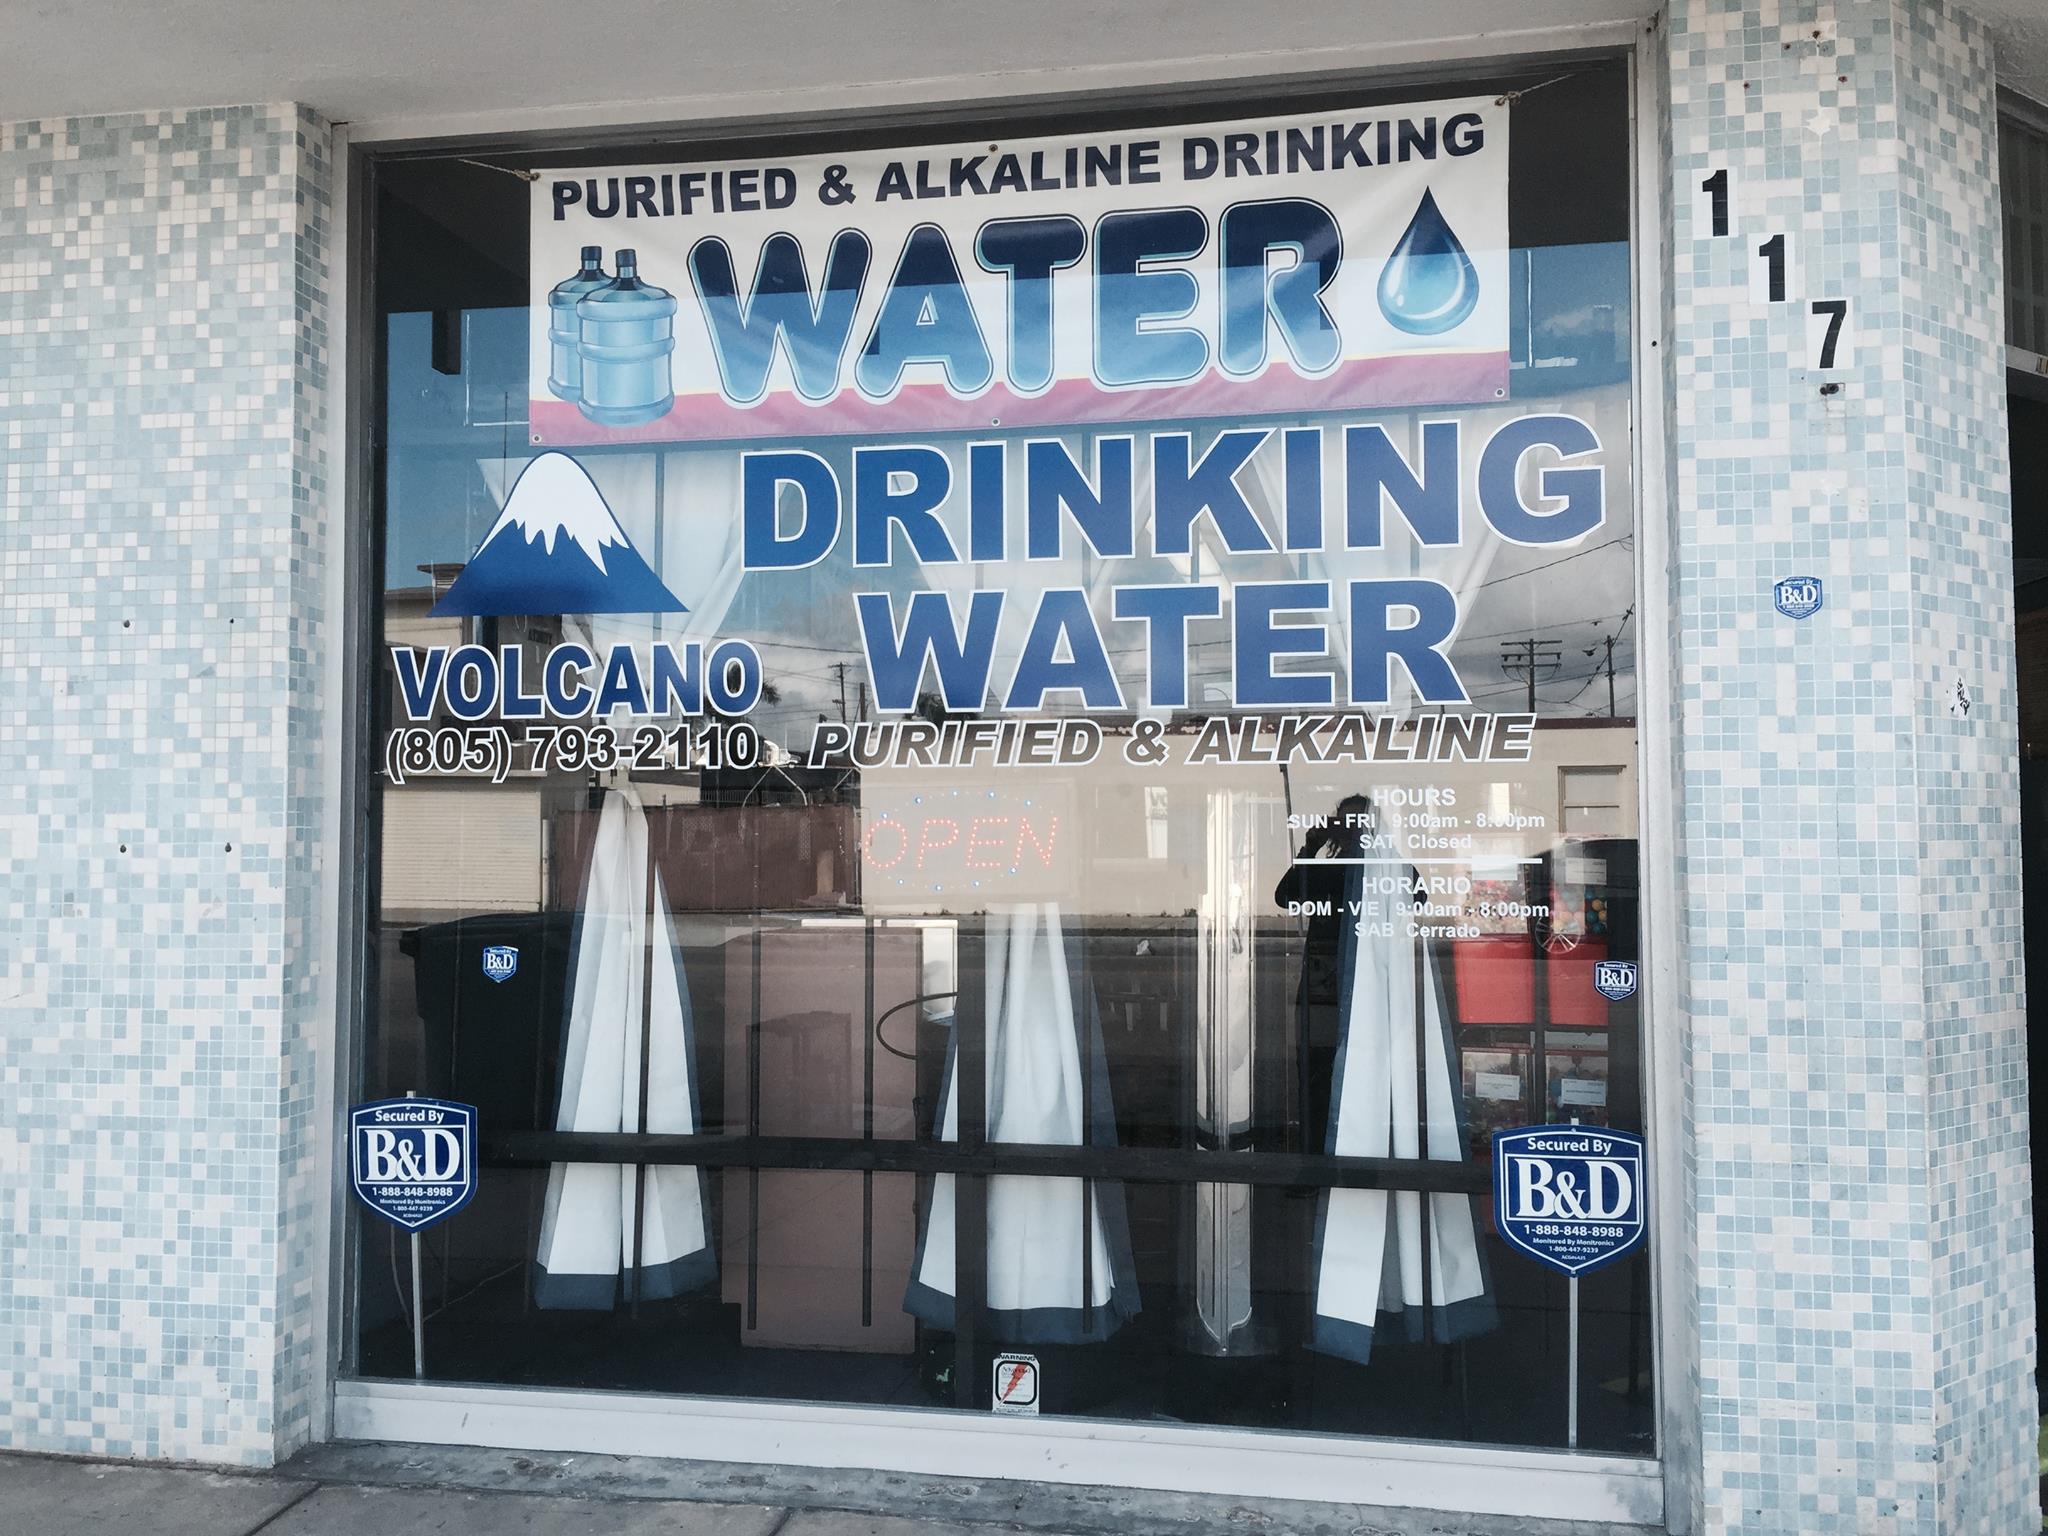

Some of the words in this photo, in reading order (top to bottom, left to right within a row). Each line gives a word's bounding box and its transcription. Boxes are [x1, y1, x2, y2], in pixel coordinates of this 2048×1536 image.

[552, 167, 797, 221] PURIFIED
[818, 165, 857, 205] &
[875, 140, 1161, 202] ALKALINE
[1183, 112, 1485, 181] DRINKING
[1702, 169, 1729, 236] 1
[1759, 234, 1786, 302] 1
[1812, 301, 1847, 369] 7
[686, 196, 1344, 407] WATER
[740, 413, 1606, 572] DRINKING
[1781, 585, 1817, 604] B&D
[852, 577, 1472, 713] WATER
[391, 638, 764, 721] VOLCANO
[806, 718, 1102, 769] PURIFIED
[1123, 717, 1171, 766] &
[1184, 712, 1537, 765] ALKALINE
[386, 726, 512, 784] (805)
[525, 722, 760, 772] 793-2110
[1373, 788, 1456, 806] HOURS
[1287, 813, 1328, 829] SUN
[1345, 813, 1376, 829] FRI
[1392, 812, 1458, 828] 9:00am
[1476, 812, 1545, 831] 8:00pm
[864, 816, 1059, 869] OPEN
[1359, 834, 1396, 849] SAT
[1408, 834, 1472, 849] Closed
[1362, 876, 1471, 895] HORARIO
[1288, 901, 1332, 916] DOM
[1348, 901, 1380, 916] VIE
[1396, 901, 1462, 917] 9:00am
[1480, 901, 1549, 920] 8:00pm
[1355, 922, 1394, 937] SAB
[1406, 922, 1480, 938] Cerrado
[487, 953, 514, 970] B&D
[1600, 968, 1633, 987] B&D
[375, 1110, 425, 1122] Secured
[428, 1111, 444, 1124] By
[364, 1129, 461, 1182] B&D
[1527, 1137, 1589, 1152] Secured
[1593, 1139, 1612, 1155] By
[372, 1187, 453, 1197] 1-888-848-8988
[1514, 1158, 1632, 1219] B&D
[1524, 1224, 1624, 1238] 1-888-848-8988
